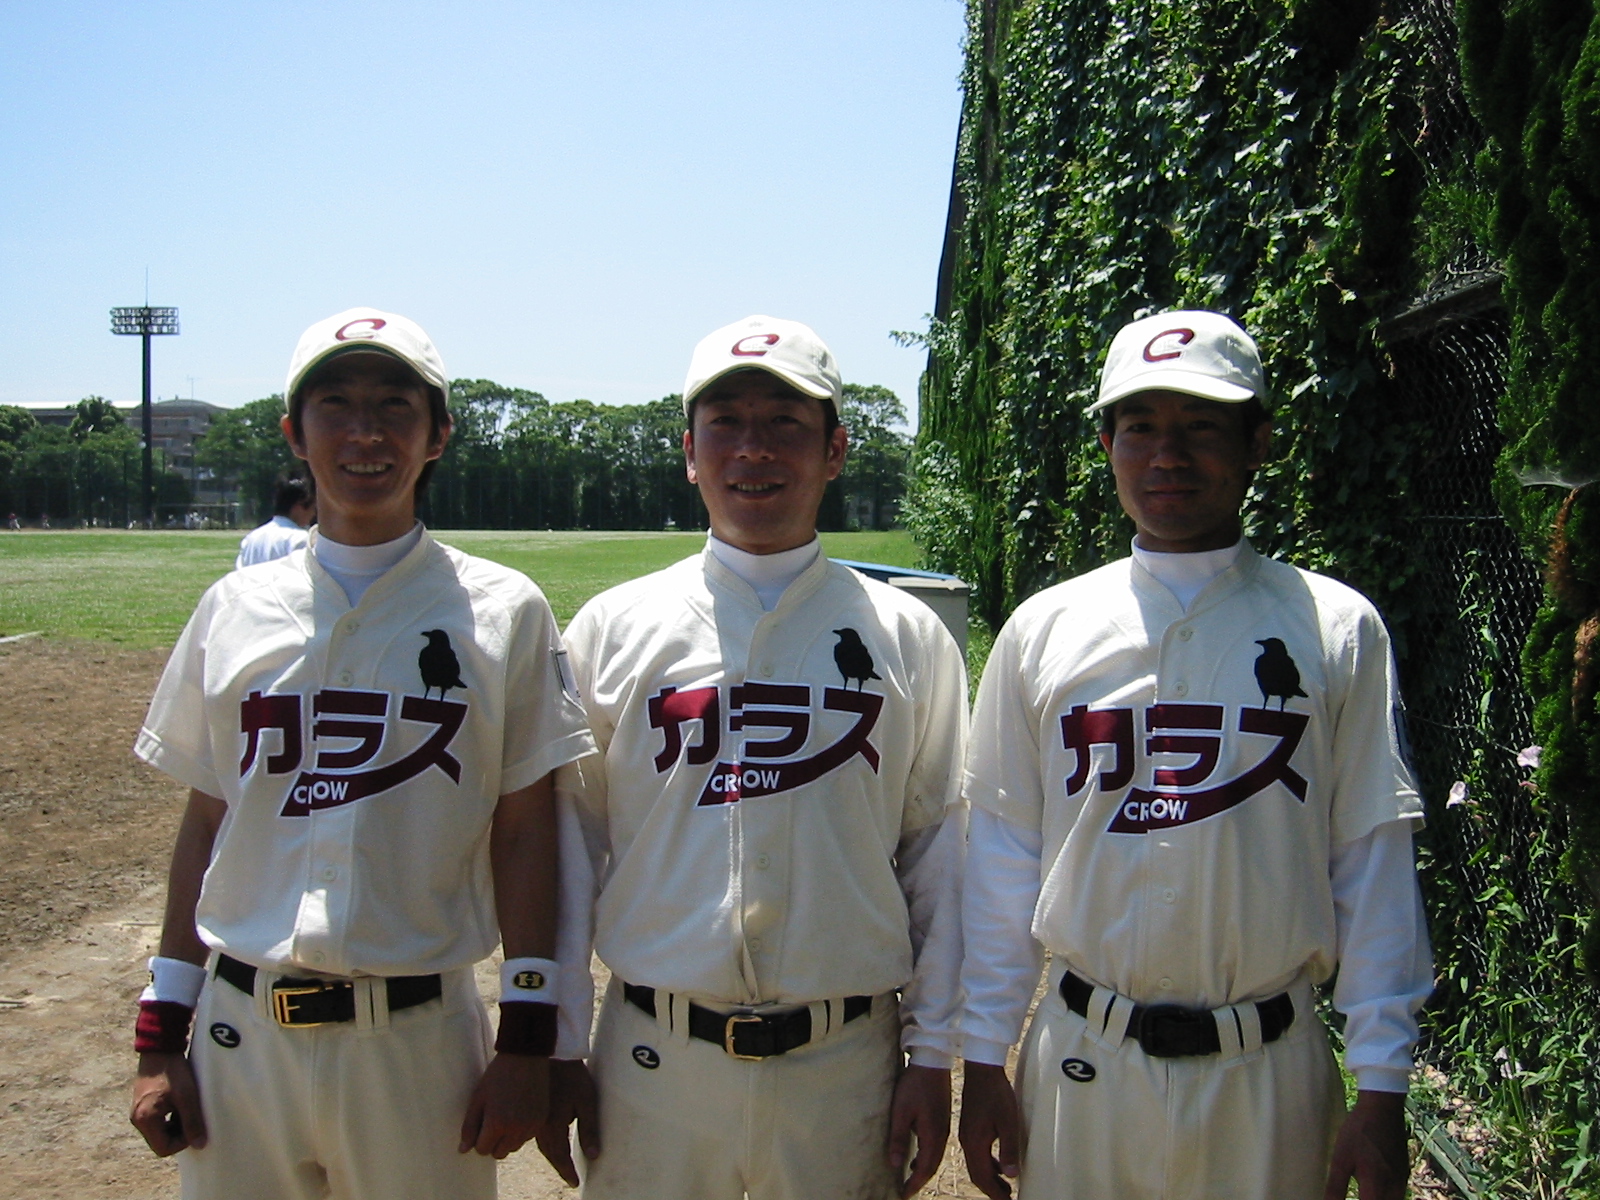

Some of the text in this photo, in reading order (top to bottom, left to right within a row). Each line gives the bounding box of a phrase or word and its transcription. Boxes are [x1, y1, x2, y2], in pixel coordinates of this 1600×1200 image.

[731, 333, 780, 356] C
[1143, 328, 1195, 362] C
[240, 688, 469, 817] カラス
[646, 681, 886, 808] カラス
[711, 769, 780, 792] CROW
[1060, 703, 1311, 835] カラス
[1123, 798, 1188, 821] CROW
